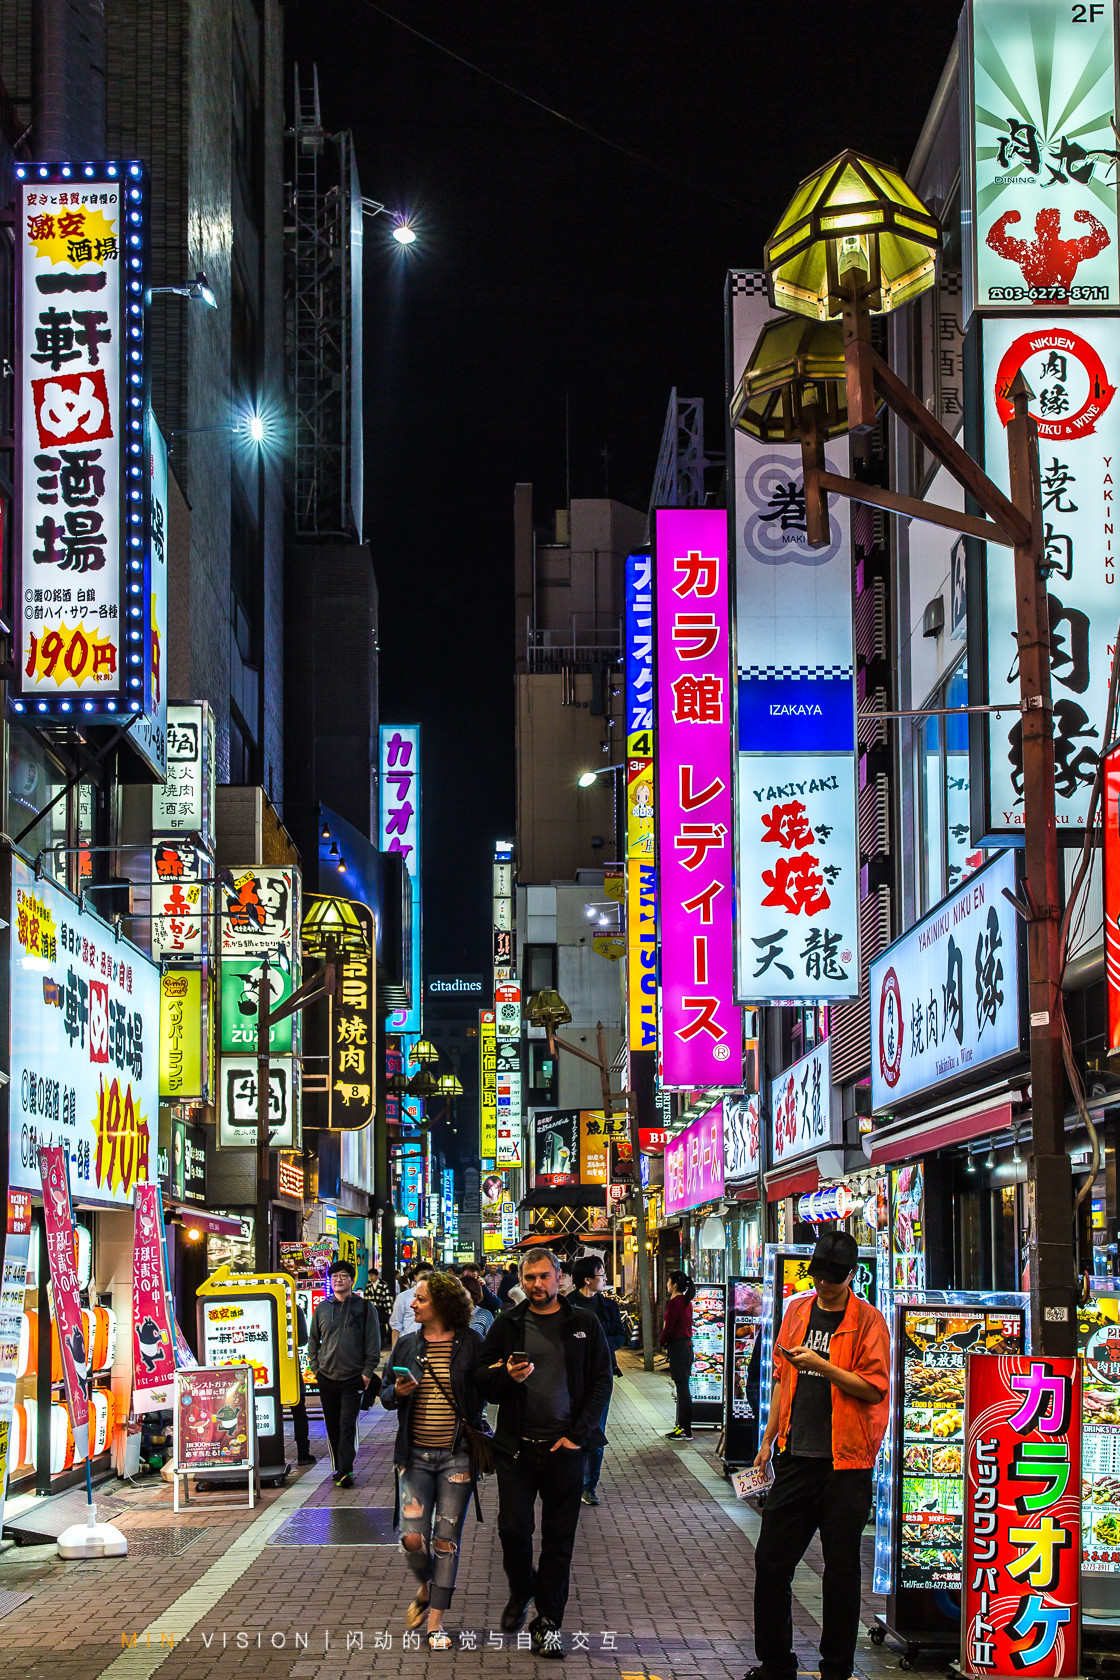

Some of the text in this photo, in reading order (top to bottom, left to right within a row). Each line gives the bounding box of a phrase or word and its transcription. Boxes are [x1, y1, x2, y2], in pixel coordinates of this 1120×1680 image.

[1072, 4, 1105, 23] 2F
[26, 212, 86, 241] 激安
[67, 237, 119, 263] 酒場
[1003, 286, 1109, 300] 03-6273-8911
[1029, 336, 1076, 351] NIKUEN
[30, 271, 114, 573] 一軒め酒場
[1072, 403, 1100, 430] WINE
[1103, 456, 1116, 585] YAKINIKU
[25, 630, 117, 677] 190円
[769, 704, 823, 716] IZAKAYA
[632, 732, 651, 755] 4
[629, 760, 646, 771] 3F
[161, 784, 194, 797] 焼肉
[671, 550, 728, 1042] カラ館 レディース
[753, 775, 839, 802] YAKIYAKI
[160, 802, 195, 815] 酒家
[170, 820, 184, 828] 5F
[918, 882, 985, 953] YAKINIKU NIKU EN
[429, 978, 482, 992] citadines
[910, 987, 938, 1059] 焼肉
[168, 1000, 183, 1091] ペッパーランチ
[336, 1014, 369, 1076] 焼肉
[497, 1059, 510, 1070] 2F
[351, 1086, 359, 1097] 8
[663, 1091, 671, 1127] BRITISH
[208, 1308, 230, 1320] 激安
[207, 1331, 269, 1344] 一軒め酒場
[1084, 1426, 1110, 1434] DRINKS
[1005, 1362, 1072, 1670] カラオケ
[924, 1580, 961, 1589] 03-6273-8080
